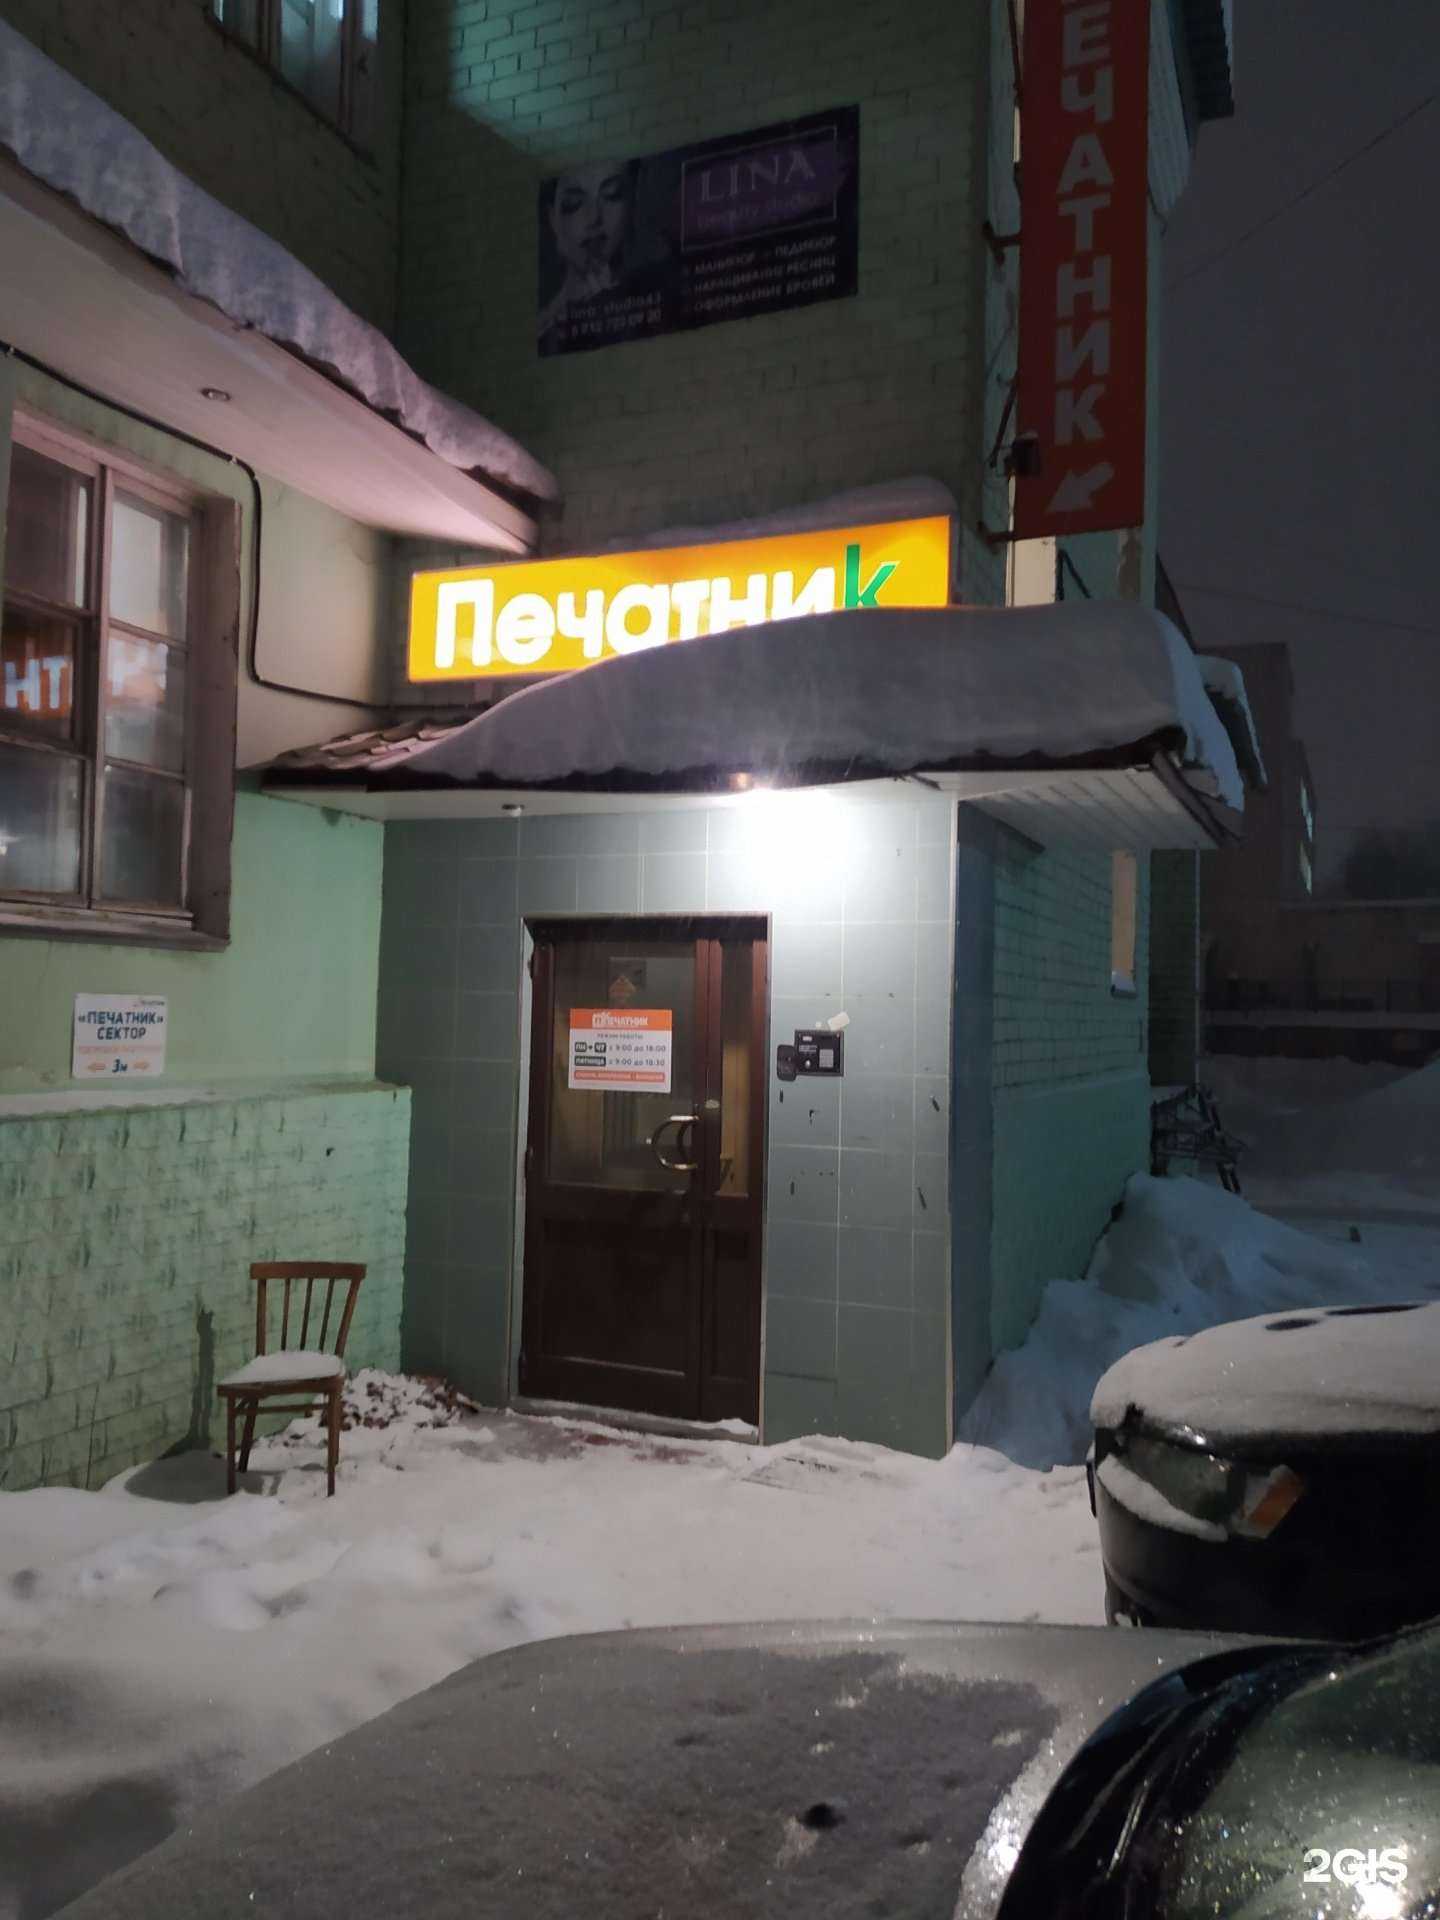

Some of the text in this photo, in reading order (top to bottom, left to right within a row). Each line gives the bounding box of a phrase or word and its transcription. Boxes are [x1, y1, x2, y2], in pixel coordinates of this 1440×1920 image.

[699, 148, 817, 203] LINA
[1053, 0, 1115, 446] ЕЧАТНИК
[96, 1026, 147, 1040] СЕКТОР
